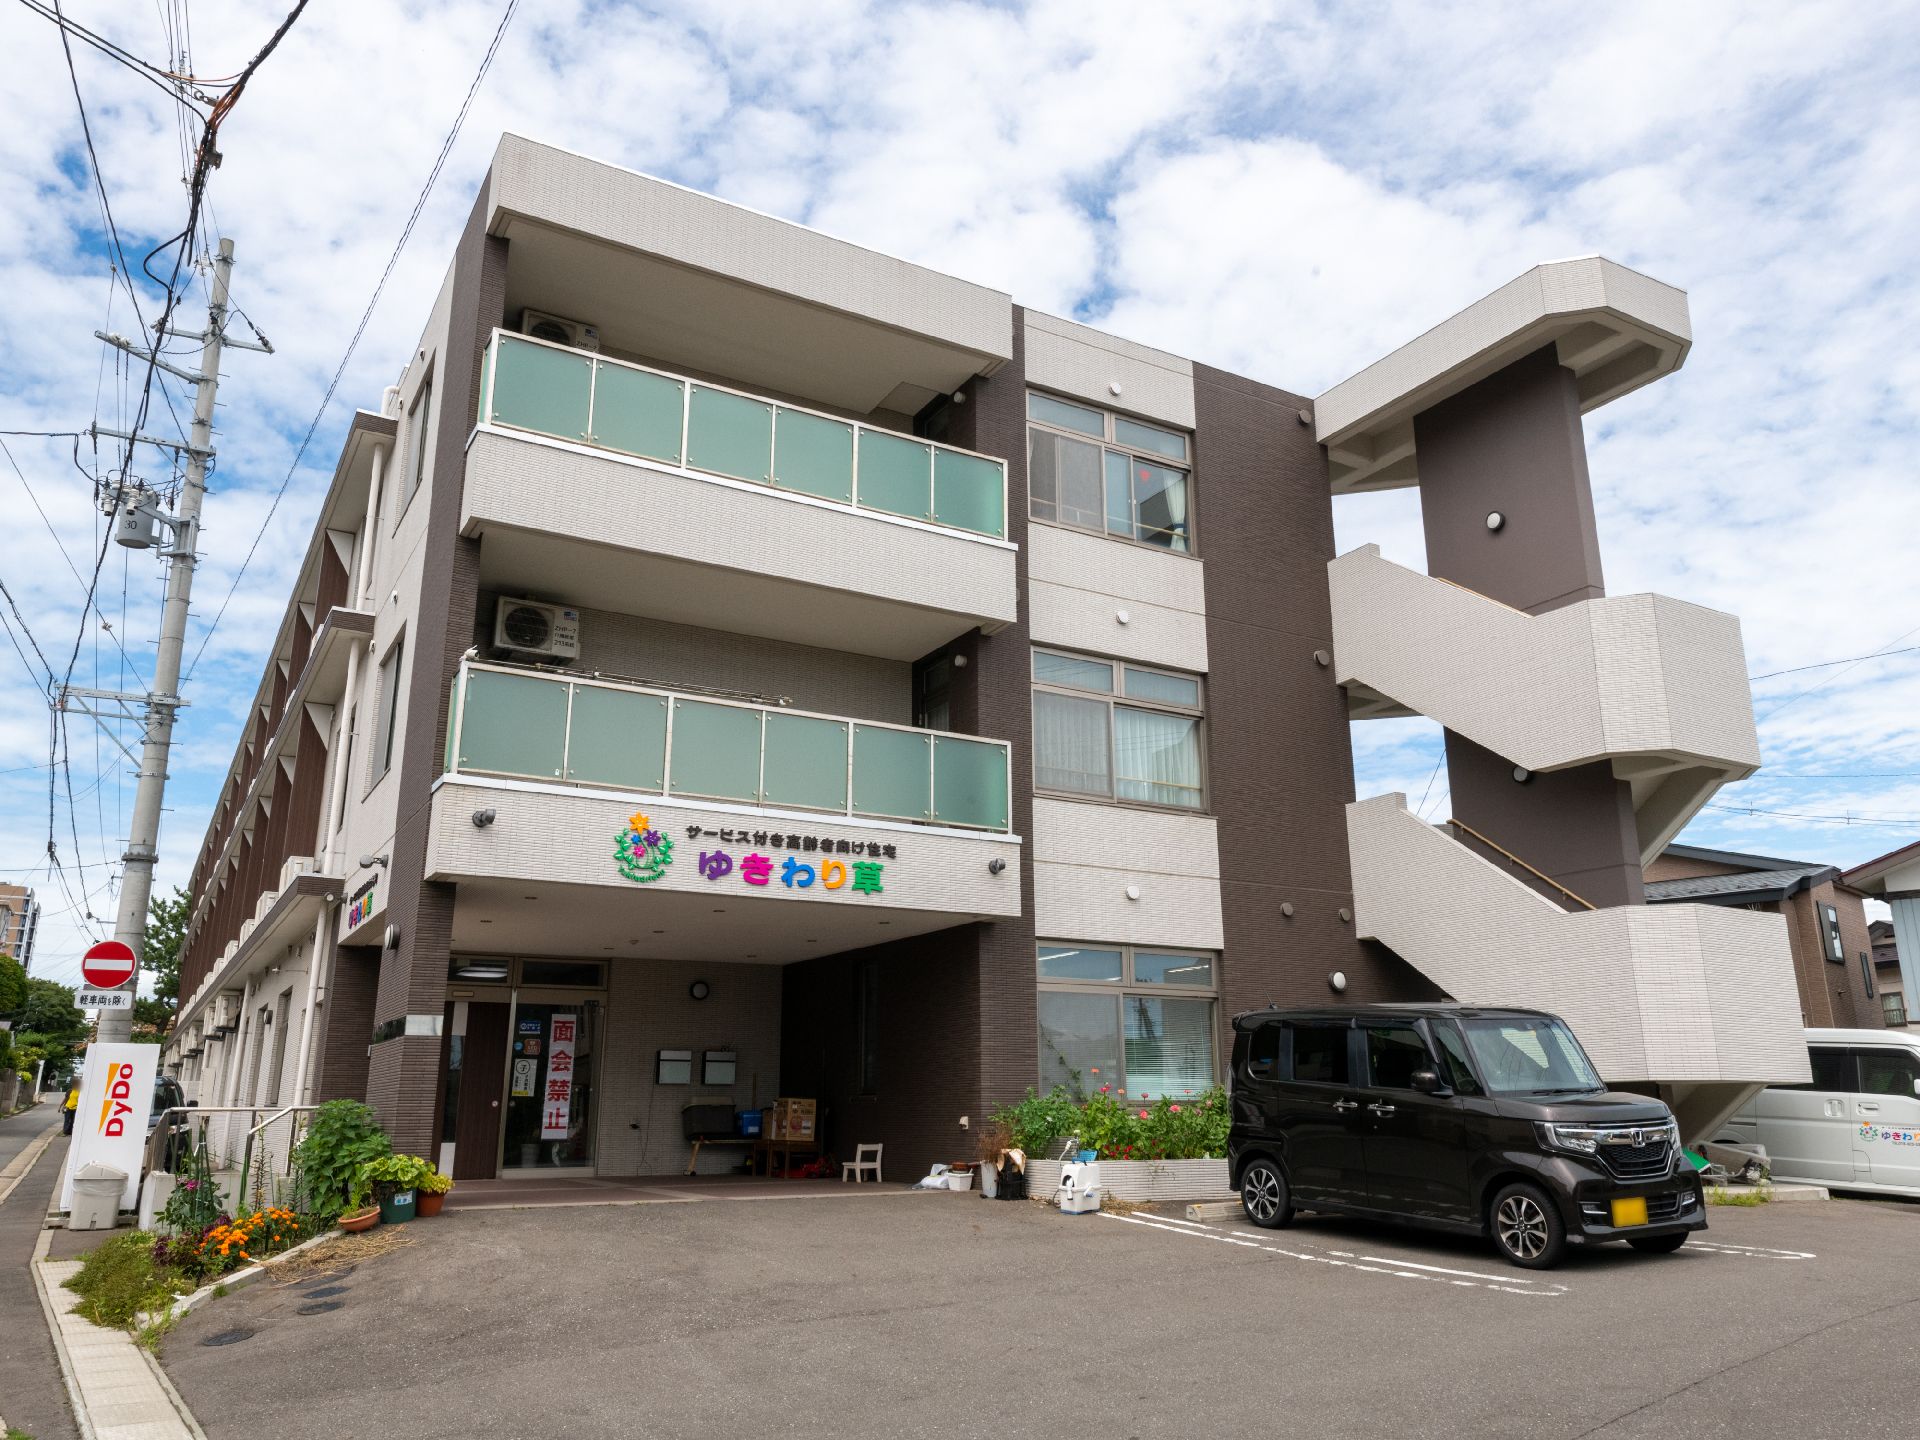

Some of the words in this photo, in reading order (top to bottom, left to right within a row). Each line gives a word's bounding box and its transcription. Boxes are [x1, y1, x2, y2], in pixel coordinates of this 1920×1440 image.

[124, 520, 137, 529] 30
[686, 825, 897, 859] サービス付き高齢者向け住宅
[699, 850, 884, 894] ゆきわり草
[79, 994, 127, 1006] 軽車両を除く
[544, 1021, 575, 1129] 面会禁止
[105, 1063, 133, 1137] DyDo
